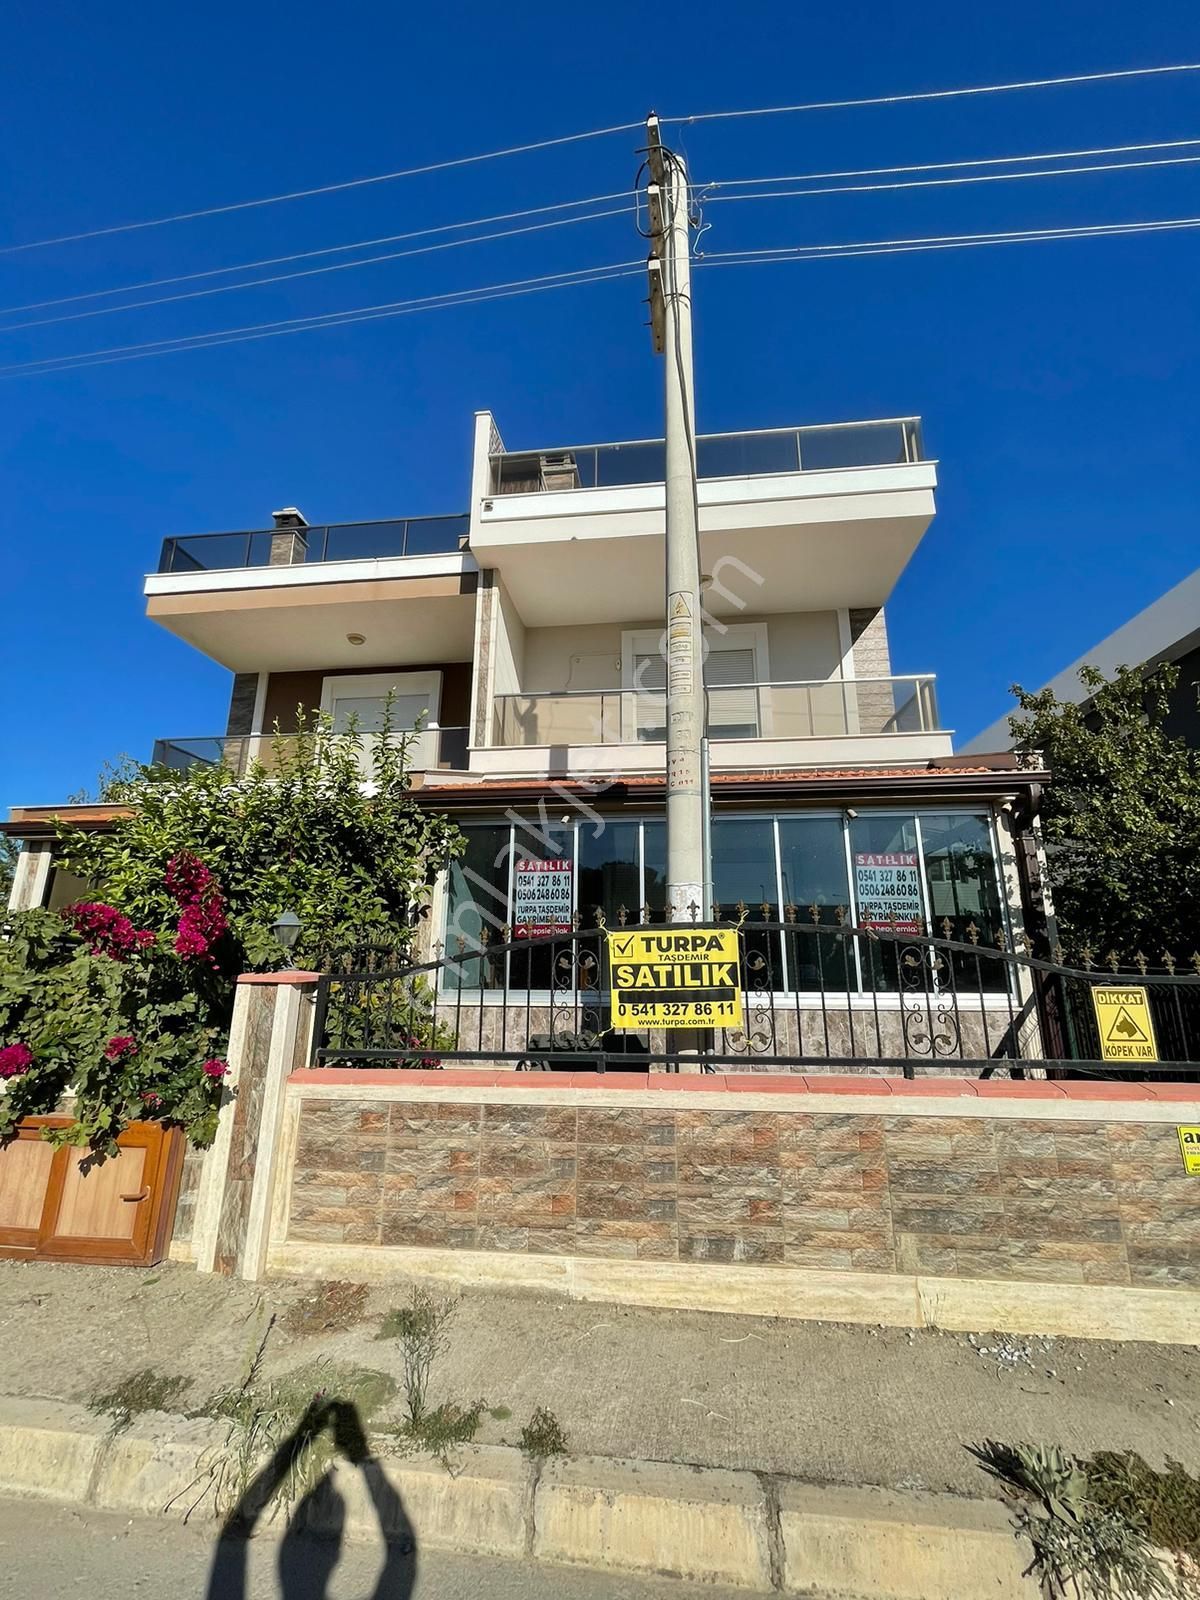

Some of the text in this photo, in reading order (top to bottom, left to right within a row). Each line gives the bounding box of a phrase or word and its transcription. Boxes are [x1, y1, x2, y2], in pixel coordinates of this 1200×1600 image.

[858, 855, 914, 864] SATILIK
[519, 861, 569, 871] SATILIK
[518, 875, 570, 887] 0541 327 86 11
[858, 870, 917, 881] 0541 327 86 11
[517, 889, 570, 900] 0506 248 60 86
[859, 884, 918, 896] 0506 248 60 86
[517, 903, 570, 914] TURPA TAŞDEMİR
[883, 899, 919, 911] TAŞDEMİR
[641, 935, 725, 953] TURPA
[658, 952, 710, 962] TAŞDEMİR
[617, 964, 735, 988] SATILIK
[1097, 991, 1143, 1005] DİKKAT
[618, 1003, 734, 1016] 0 541 327 86 11
[638, 1018, 716, 1026] www.turpa.com.tr
[1105, 1044, 1153, 1057] KÖPEK VAR
